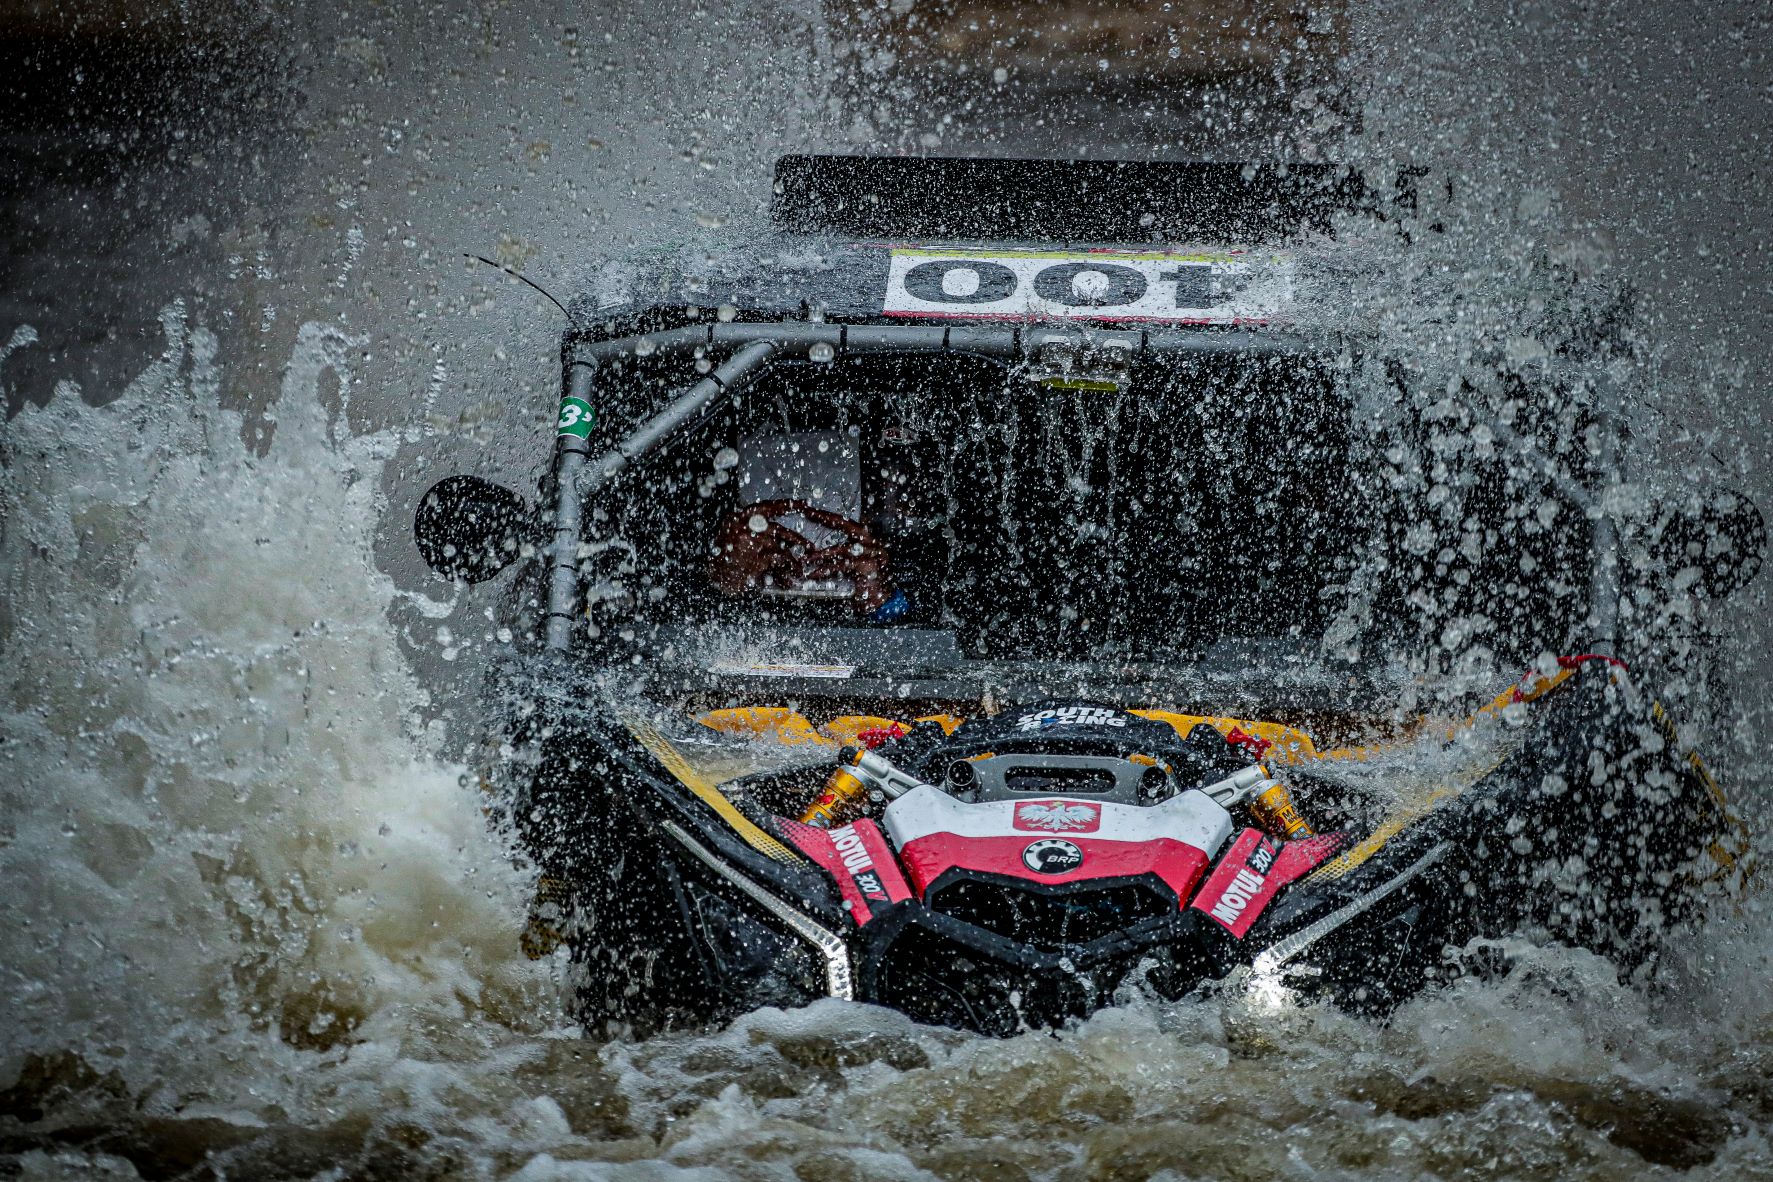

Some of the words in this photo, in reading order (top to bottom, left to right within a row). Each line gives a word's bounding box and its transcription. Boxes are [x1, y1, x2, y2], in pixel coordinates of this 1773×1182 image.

[1016, 706, 1115, 726] SOUTH
[828, 824, 873, 875] MOTUL
[856, 874, 889, 901] 300V
[1046, 855, 1080, 864] BRP
[1211, 869, 1265, 926] MOTUL
[1252, 838, 1277, 873] 300V
